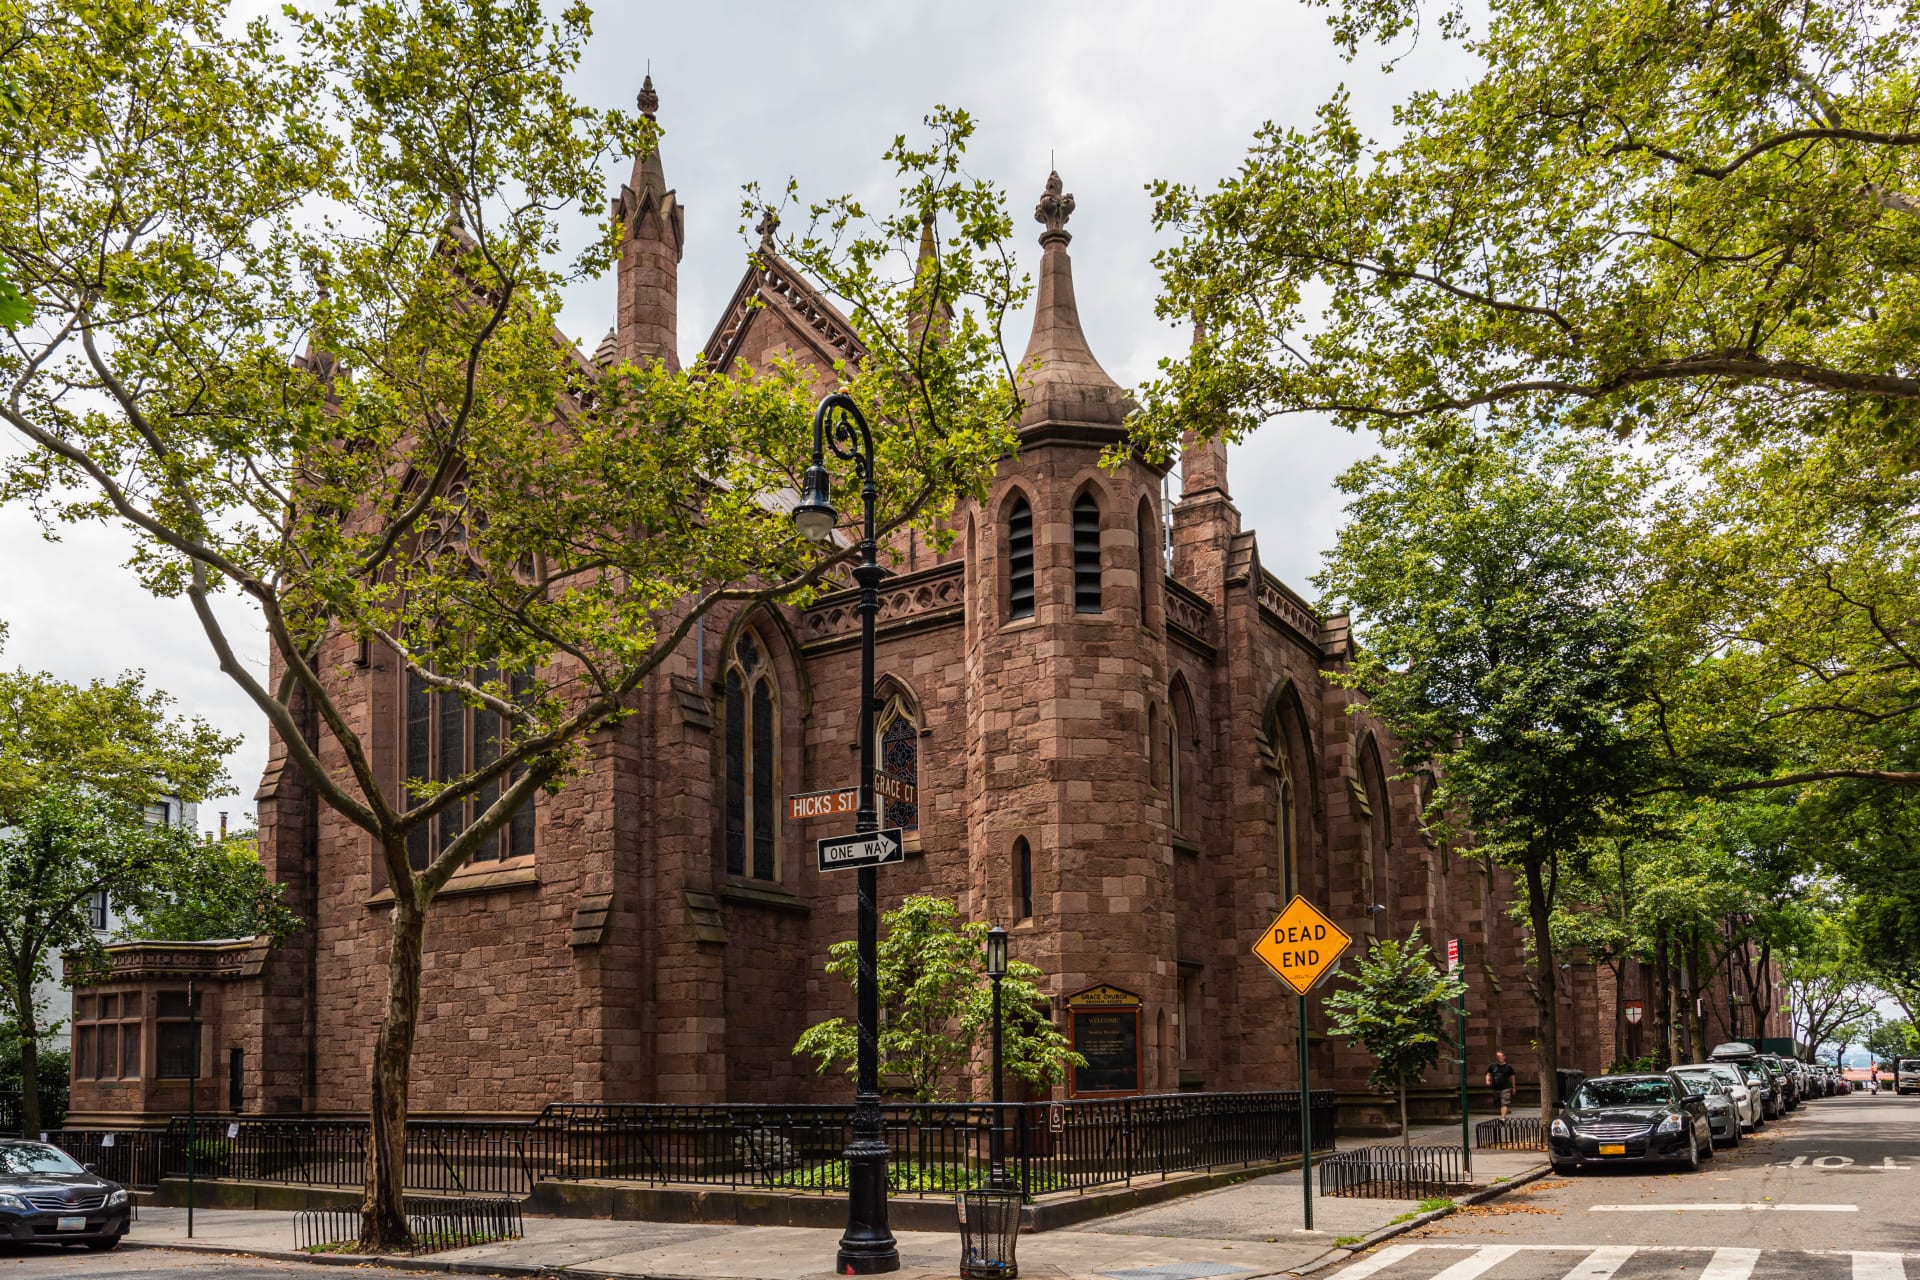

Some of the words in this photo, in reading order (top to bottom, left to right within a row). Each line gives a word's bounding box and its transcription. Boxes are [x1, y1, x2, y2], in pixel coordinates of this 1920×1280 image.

[874, 774, 901, 798] GRACE
[904, 785, 914, 803] CT
[793, 796, 832, 817] HICKS
[838, 792, 854, 811] ST
[830, 845, 854, 860] ONE
[864, 840, 889, 856] WAY
[1275, 925, 1326, 944] DEAD
[1283, 950, 1319, 968] END
